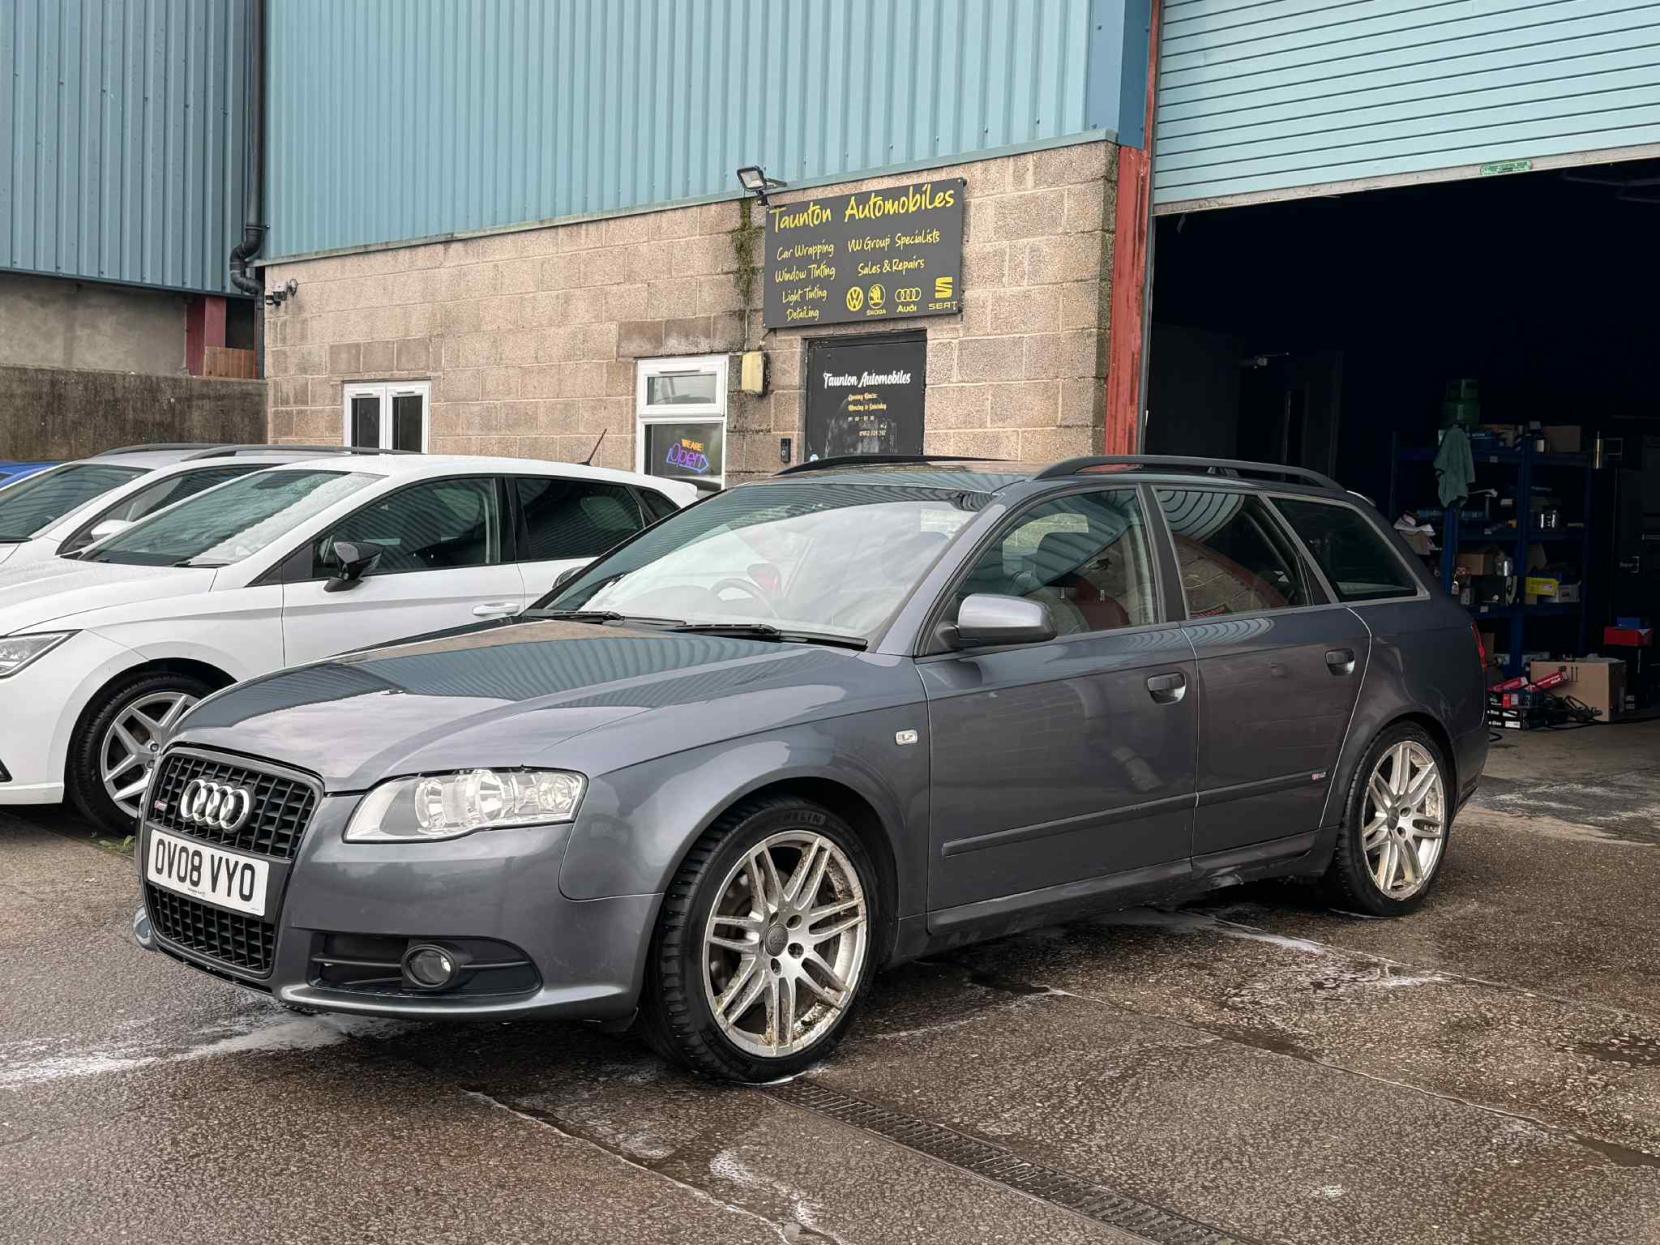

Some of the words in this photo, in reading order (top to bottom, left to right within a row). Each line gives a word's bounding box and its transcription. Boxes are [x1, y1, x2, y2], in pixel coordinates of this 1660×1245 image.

[769, 201, 832, 233] Taunton
[844, 184, 955, 223] Automobiles
[776, 247, 794, 261] Car
[794, 239, 834, 261] Wrapping
[863, 234, 891, 252] Group
[895, 228, 940, 250] Specialists
[775, 265, 807, 283] Window
[808, 260, 836, 281] Tinting
[857, 261, 881, 277] Sales
[882, 259, 891, 273] &
[892, 255, 925, 276] Repairs
[782, 288, 804, 306] Light
[804, 284, 827, 302] Tinting
[786, 306, 819, 322] Detailing
[896, 304, 918, 313] Audi
[928, 301, 958, 312] SEAT
[823, 371, 858, 389] Taunton
[858, 370, 912, 388] Automobiles
[671, 443, 705, 468] Open
[155, 838, 202, 888] OV08
[210, 854, 255, 902] VYO
